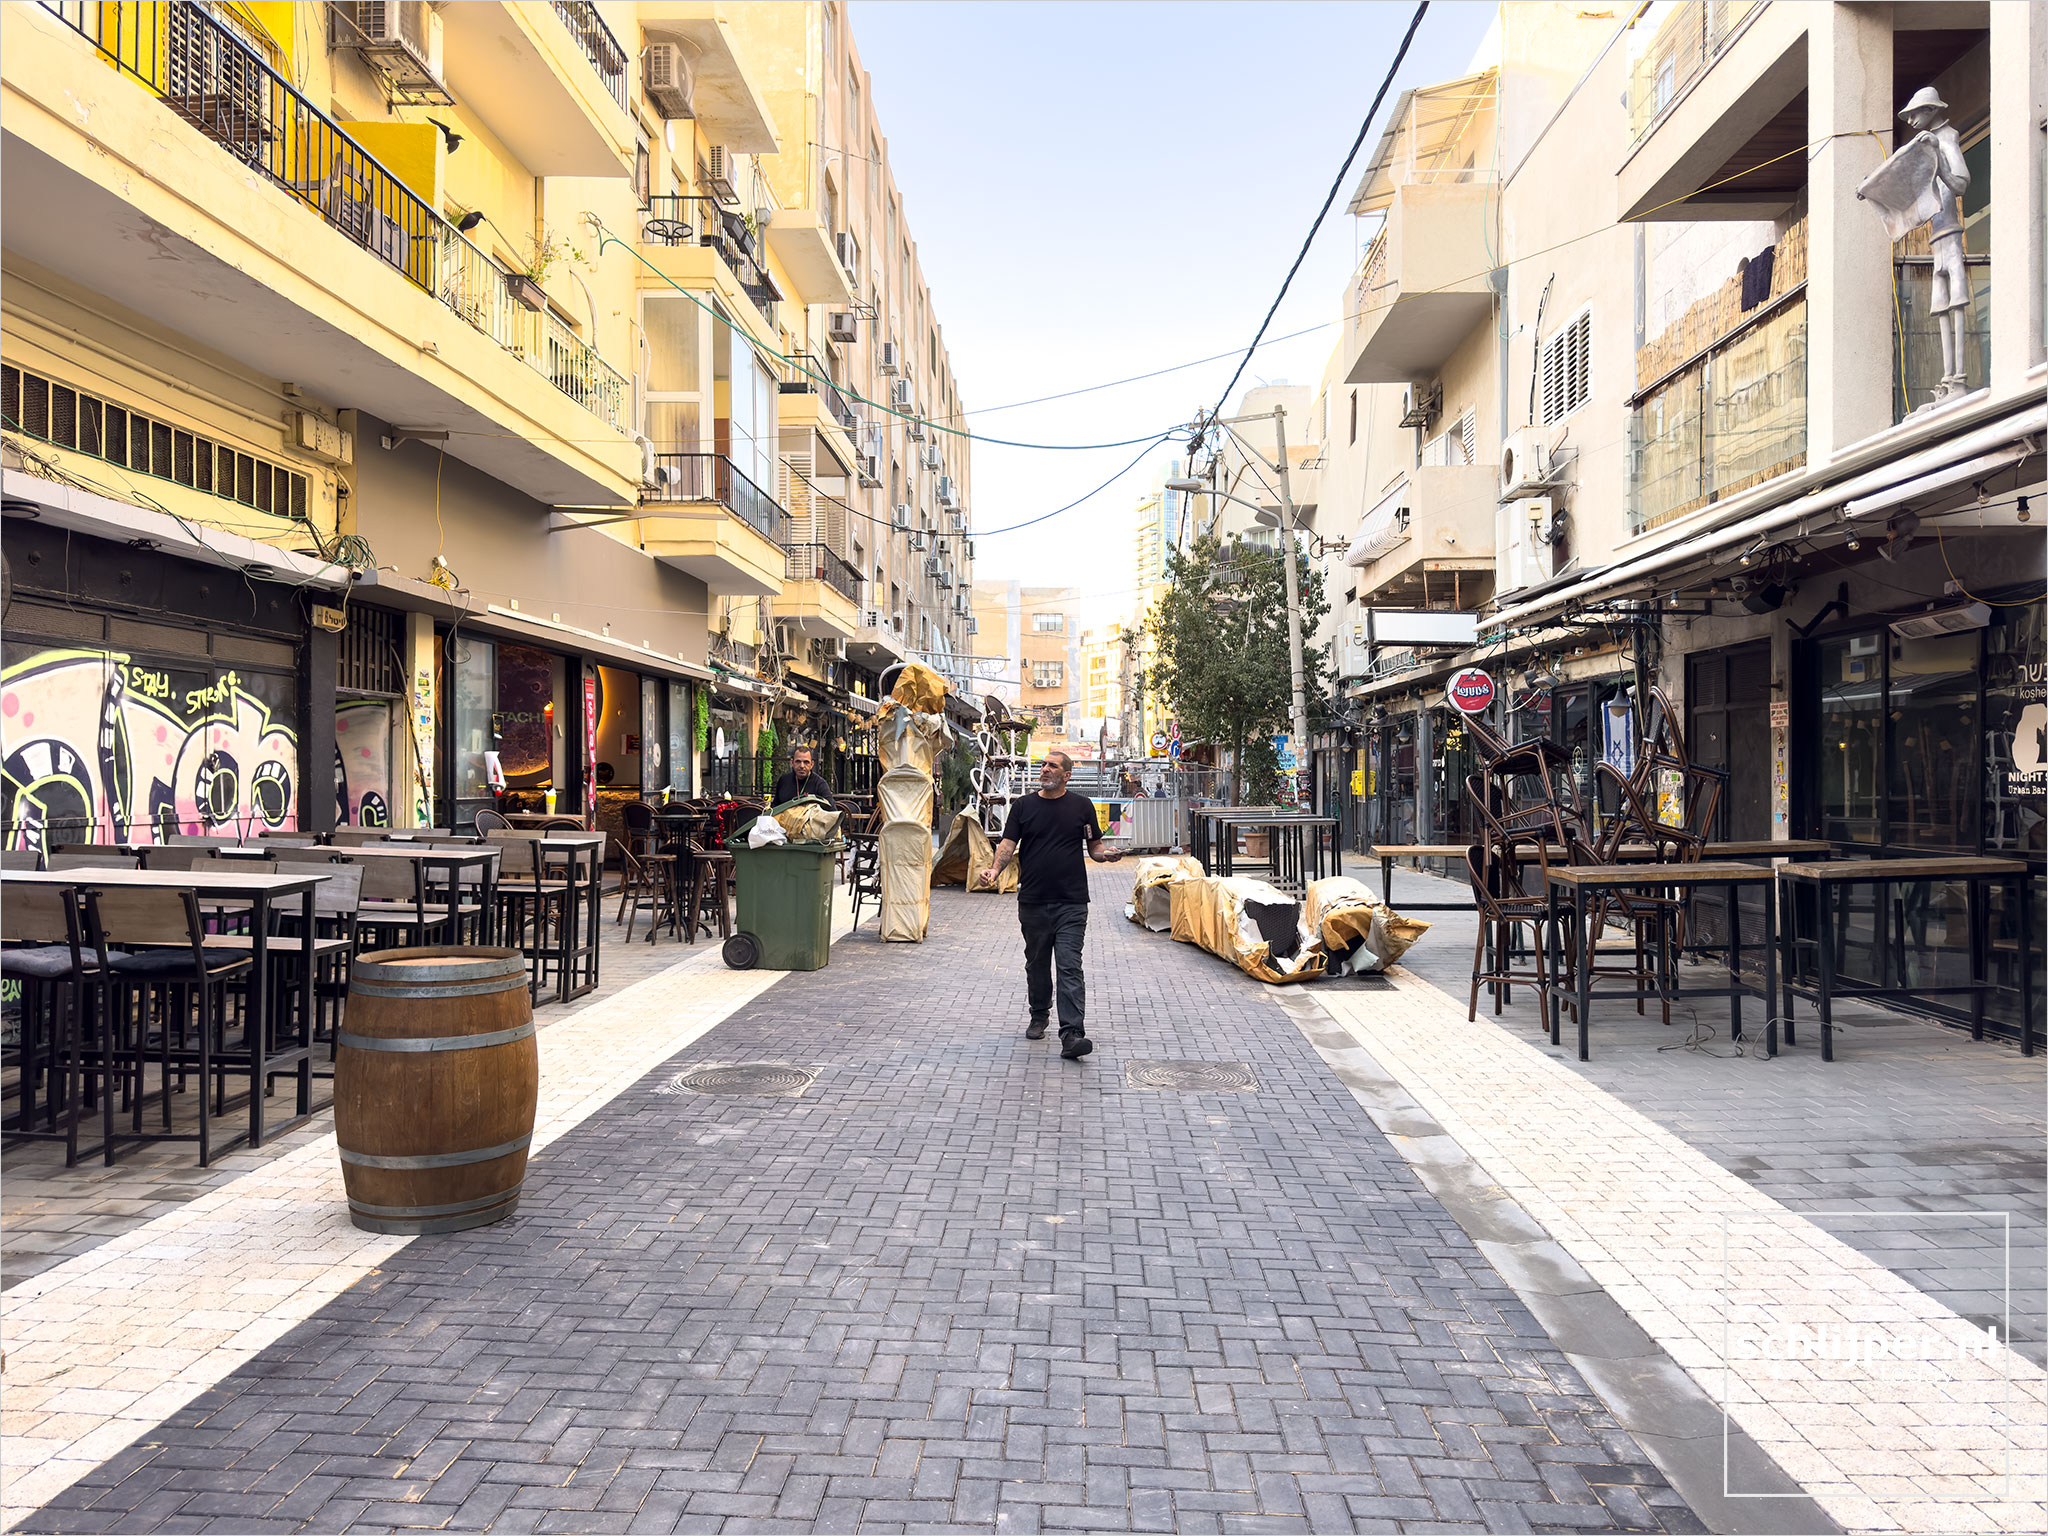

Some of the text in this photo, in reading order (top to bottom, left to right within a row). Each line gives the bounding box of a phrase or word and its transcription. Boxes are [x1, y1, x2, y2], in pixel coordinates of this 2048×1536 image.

[2008, 772, 2043, 782] NIGHT
[2008, 785, 2047, 795] Urban Bar
